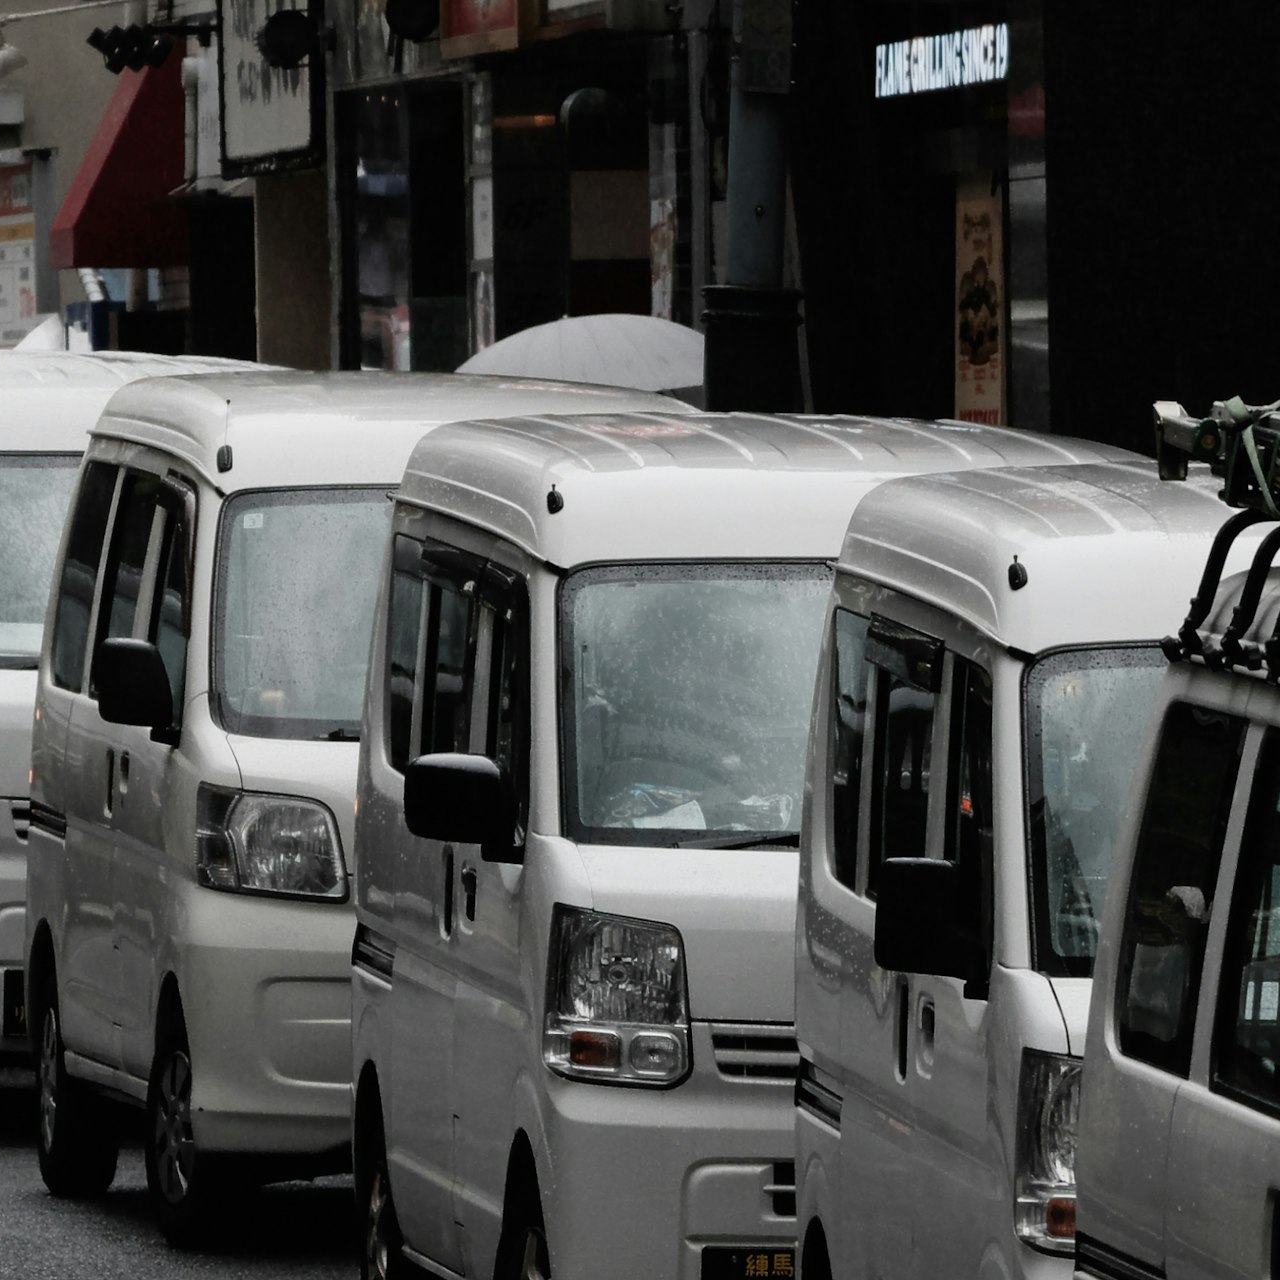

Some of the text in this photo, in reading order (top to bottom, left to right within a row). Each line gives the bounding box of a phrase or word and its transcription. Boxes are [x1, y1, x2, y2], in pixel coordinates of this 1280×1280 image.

[875, 39, 910, 98] FLAME
[910, 31, 961, 93] GRILLING
[962, 24, 994, 85] SINCE
[745, 1253, 794, 1278] 練馬
